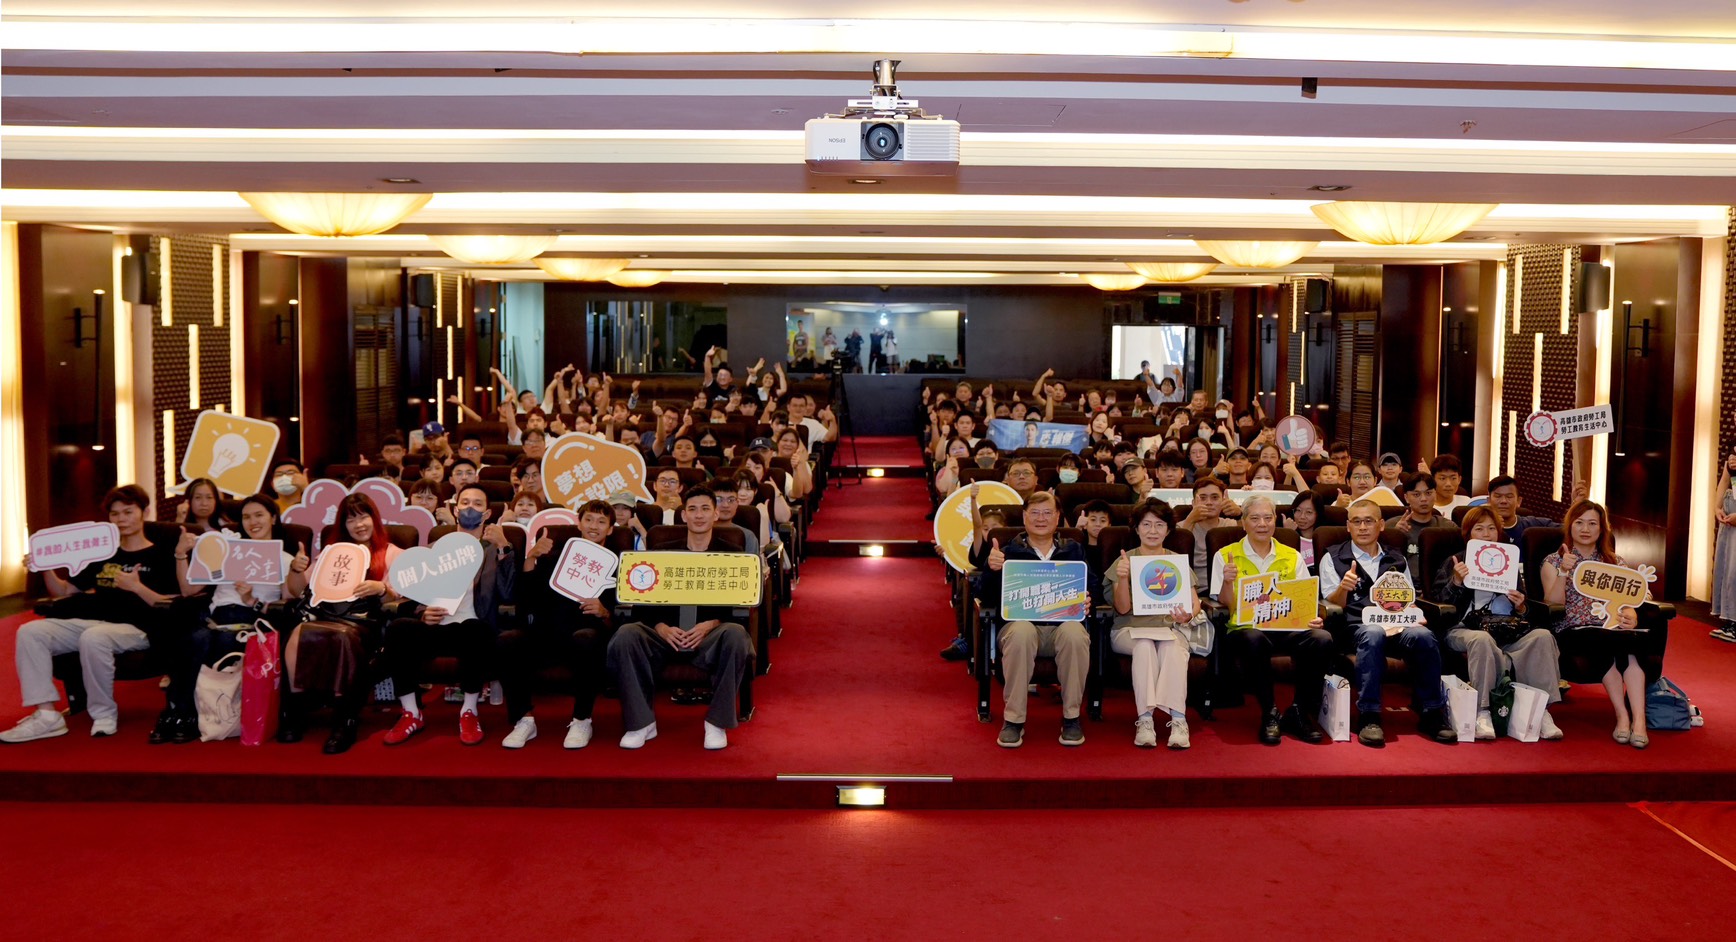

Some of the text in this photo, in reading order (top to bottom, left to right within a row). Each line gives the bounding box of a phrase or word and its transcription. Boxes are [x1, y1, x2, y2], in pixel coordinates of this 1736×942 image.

[1560, 411, 1606, 425] 高雄市政府勞工局
[1561, 421, 1608, 434] 勞工教育生活中心
[554, 459, 597, 496] 夢想
[231, 545, 262, 560] 名人
[244, 559, 278, 580] 分享
[328, 554, 354, 587] 故事
[397, 544, 477, 589] 個人品牌
[572, 551, 604, 577] 勞教
[663, 566, 750, 578] 高雄市政府勞工局
[566, 566, 596, 589] 中心
[662, 579, 749, 591] 勞工教育生活中心
[1580, 569, 1642, 597] 與你同行
[1243, 578, 1282, 603] 職人
[1376, 590, 1410, 601] 勞工大學
[1254, 597, 1293, 625] 精神
[1369, 614, 1417, 624] 高雄市勞工大學
